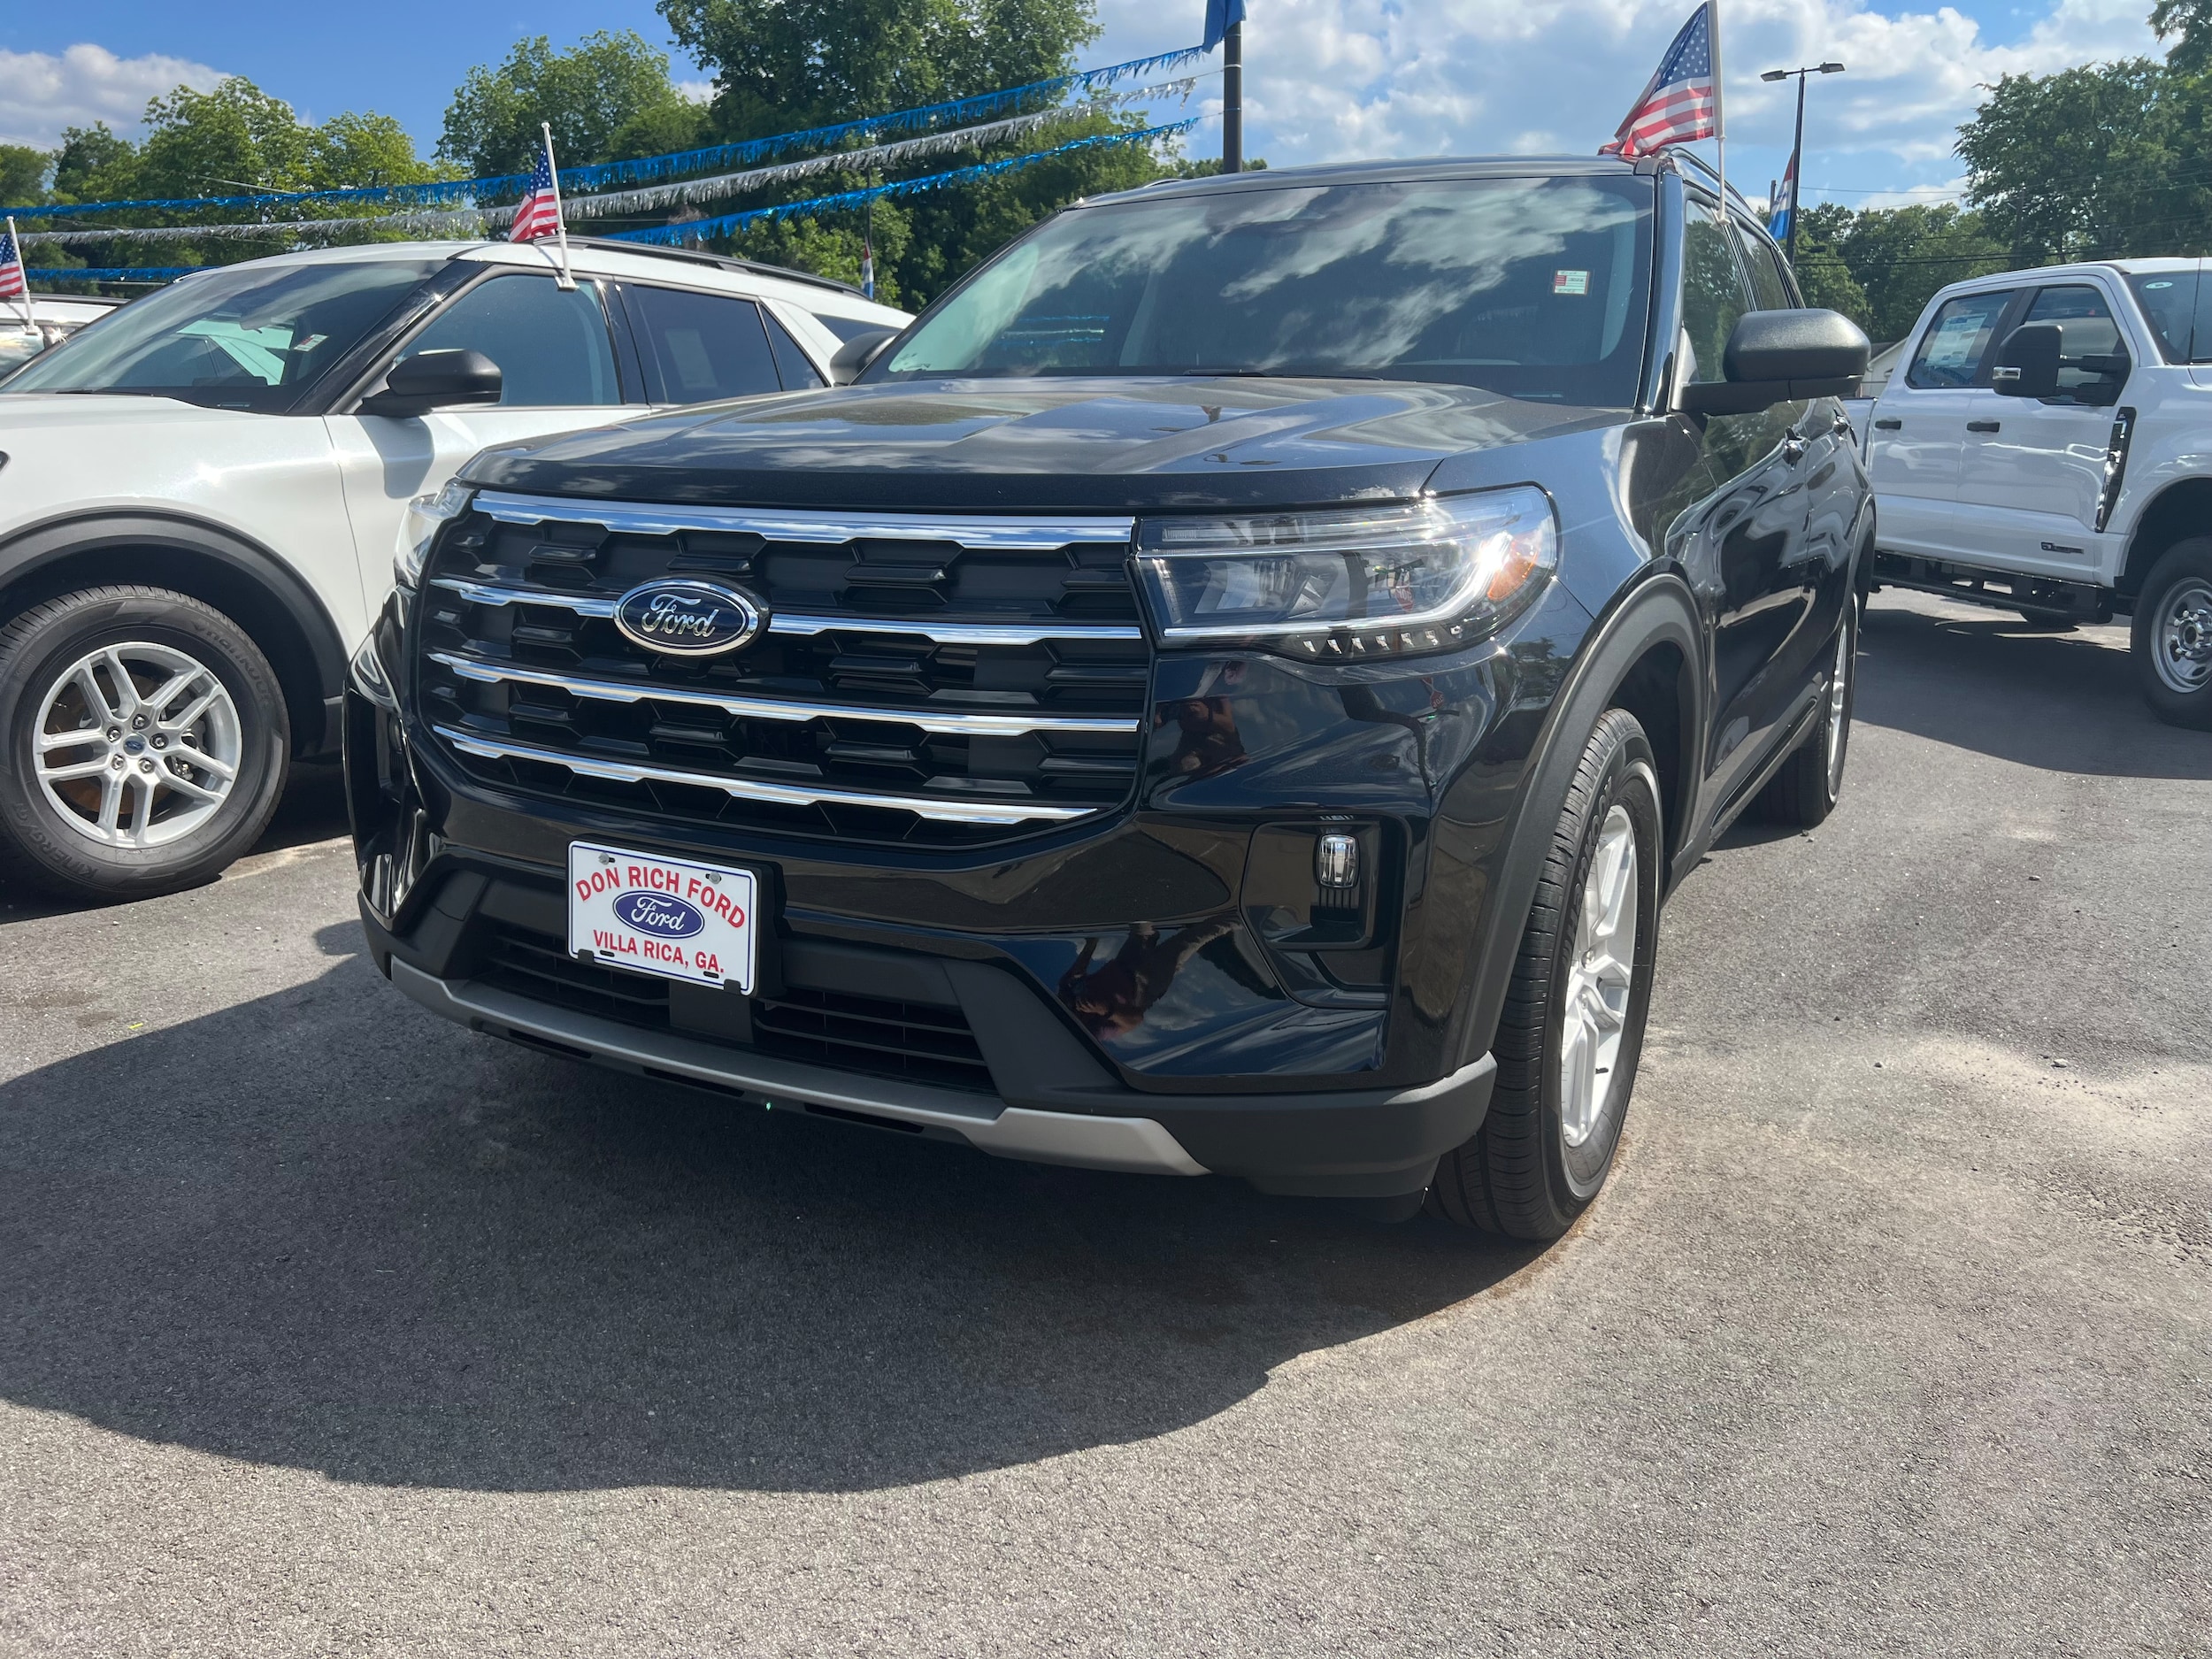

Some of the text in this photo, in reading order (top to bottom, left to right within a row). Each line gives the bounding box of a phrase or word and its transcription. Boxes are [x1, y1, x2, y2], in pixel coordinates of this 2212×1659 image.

[641, 594, 720, 637] Ford
[576, 866, 745, 928] DON RICH FORD
[631, 896, 686, 931] Ford
[594, 929, 725, 973] VILLA RICA, GA.
